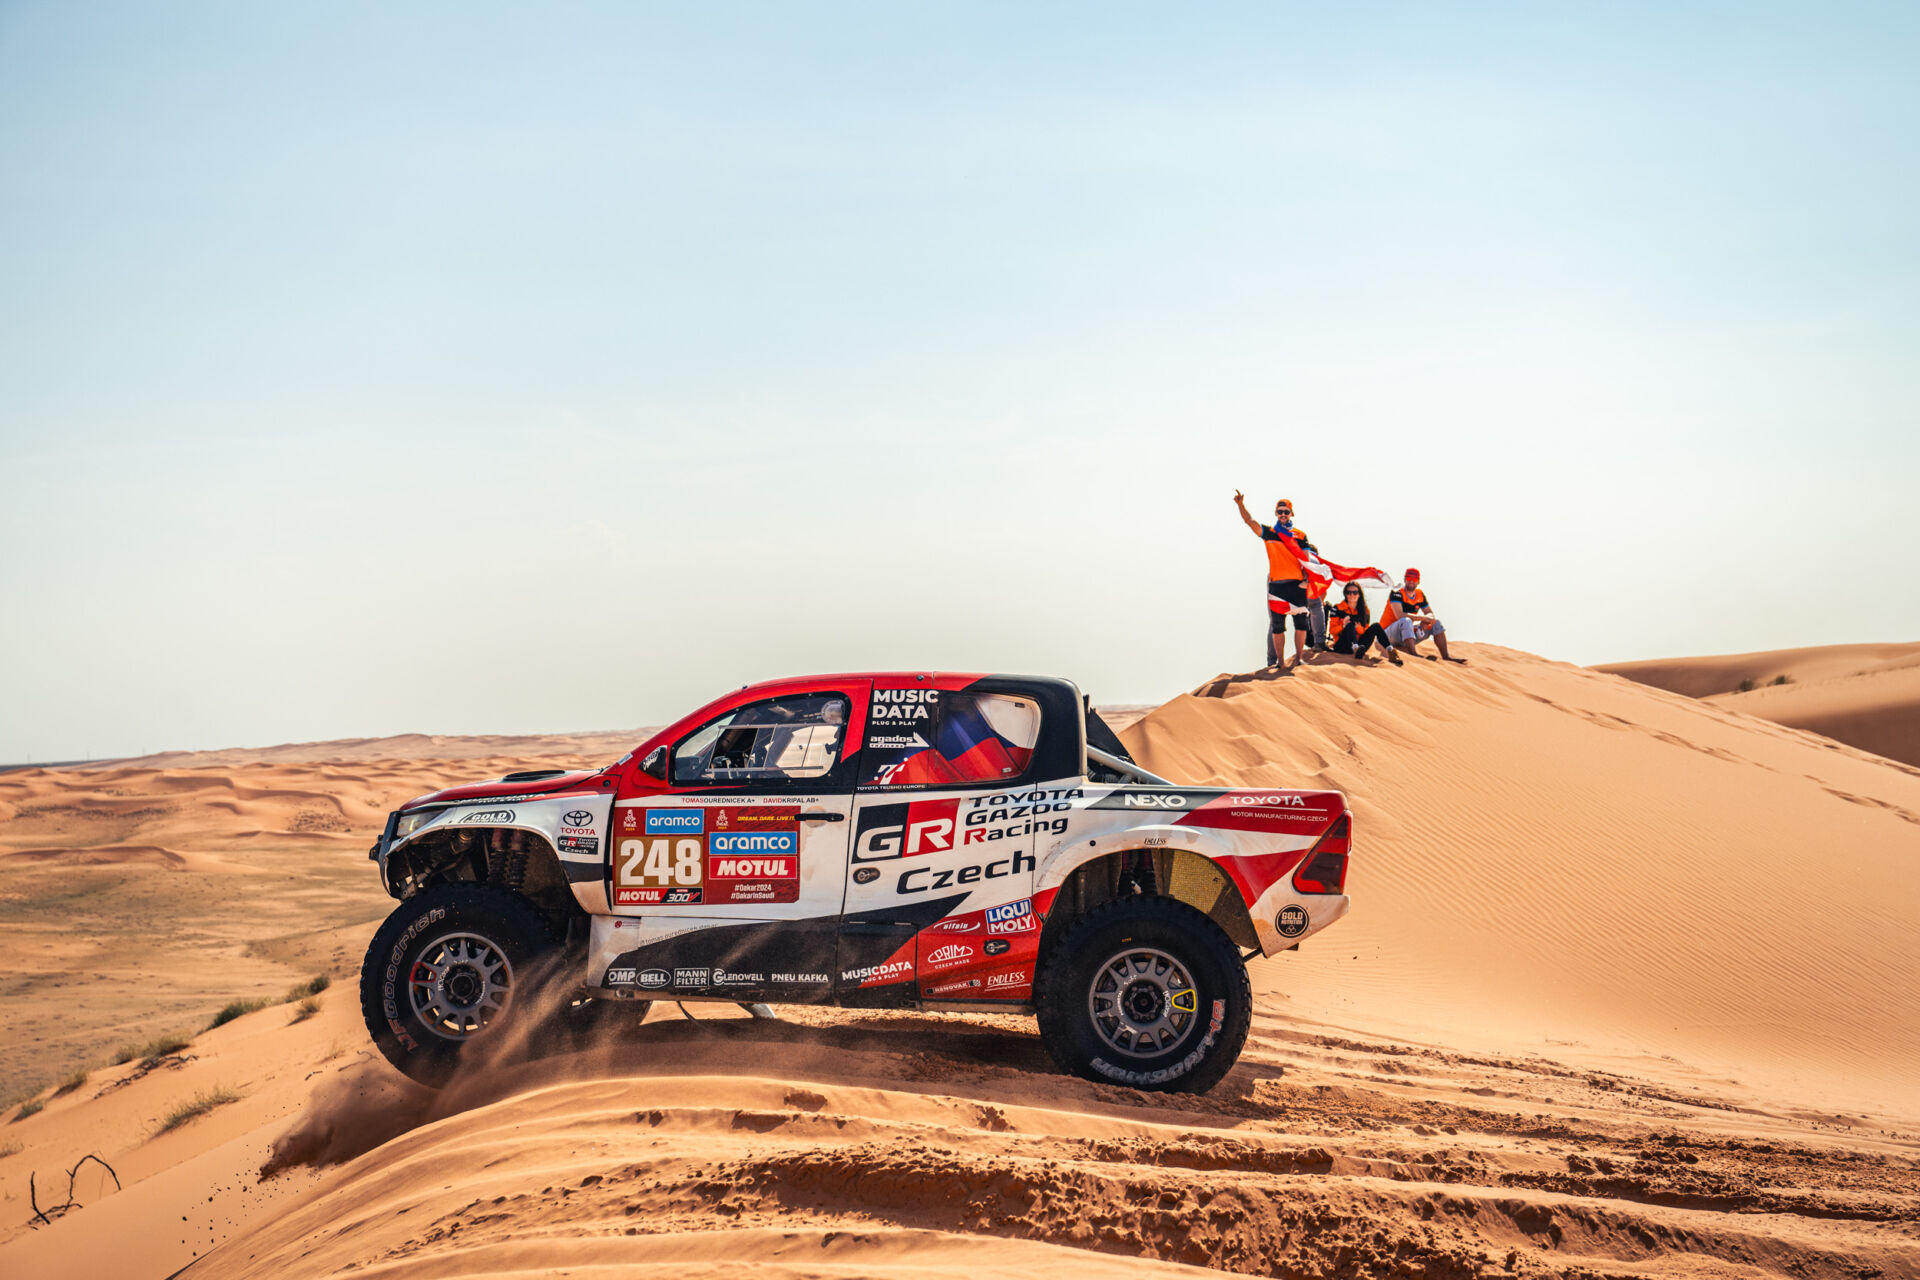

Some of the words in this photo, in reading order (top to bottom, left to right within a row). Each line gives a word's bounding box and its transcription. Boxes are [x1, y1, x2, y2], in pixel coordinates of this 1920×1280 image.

[873, 690, 939, 703] MUSIC
[872, 705, 929, 719] DATA
[870, 735, 914, 744] agados
[968, 789, 1085, 808] TOYOTA
[1124, 794, 1187, 808] NEXO
[1230, 795, 1305, 806] TOYOTA
[472, 812, 508, 820] GOLD
[965, 803, 1073, 826] GAZOO
[1254, 812, 1306, 821] MANUFACTURING
[649, 817, 700, 826] aramco
[560, 827, 596, 836] TOYOTA
[964, 818, 1069, 846] Racing
[559, 839, 577, 847] GR
[715, 836, 790, 850] aramco
[856, 818, 954, 860] GR
[620, 839, 702, 886] 248
[717, 860, 789, 876] MOTUL
[896, 850, 1036, 895] Czech
[734, 884, 772, 892] #Dakar2024
[619, 891, 661, 901] MOTUL
[666, 892, 700, 902] 300V
[988, 901, 1029, 922] LIQUI
[1281, 911, 1304, 920] GOLD
[990, 915, 1031, 932] MOLY
[934, 945, 966, 960] PRIM
[608, 971, 636, 983] OMP
[640, 973, 667, 982] BELL
[842, 961, 913, 981] MUSICDATA
[772, 974, 795, 982] PNEU
[798, 974, 829, 982] KAFKA
[987, 971, 1025, 986] ENDLESS
